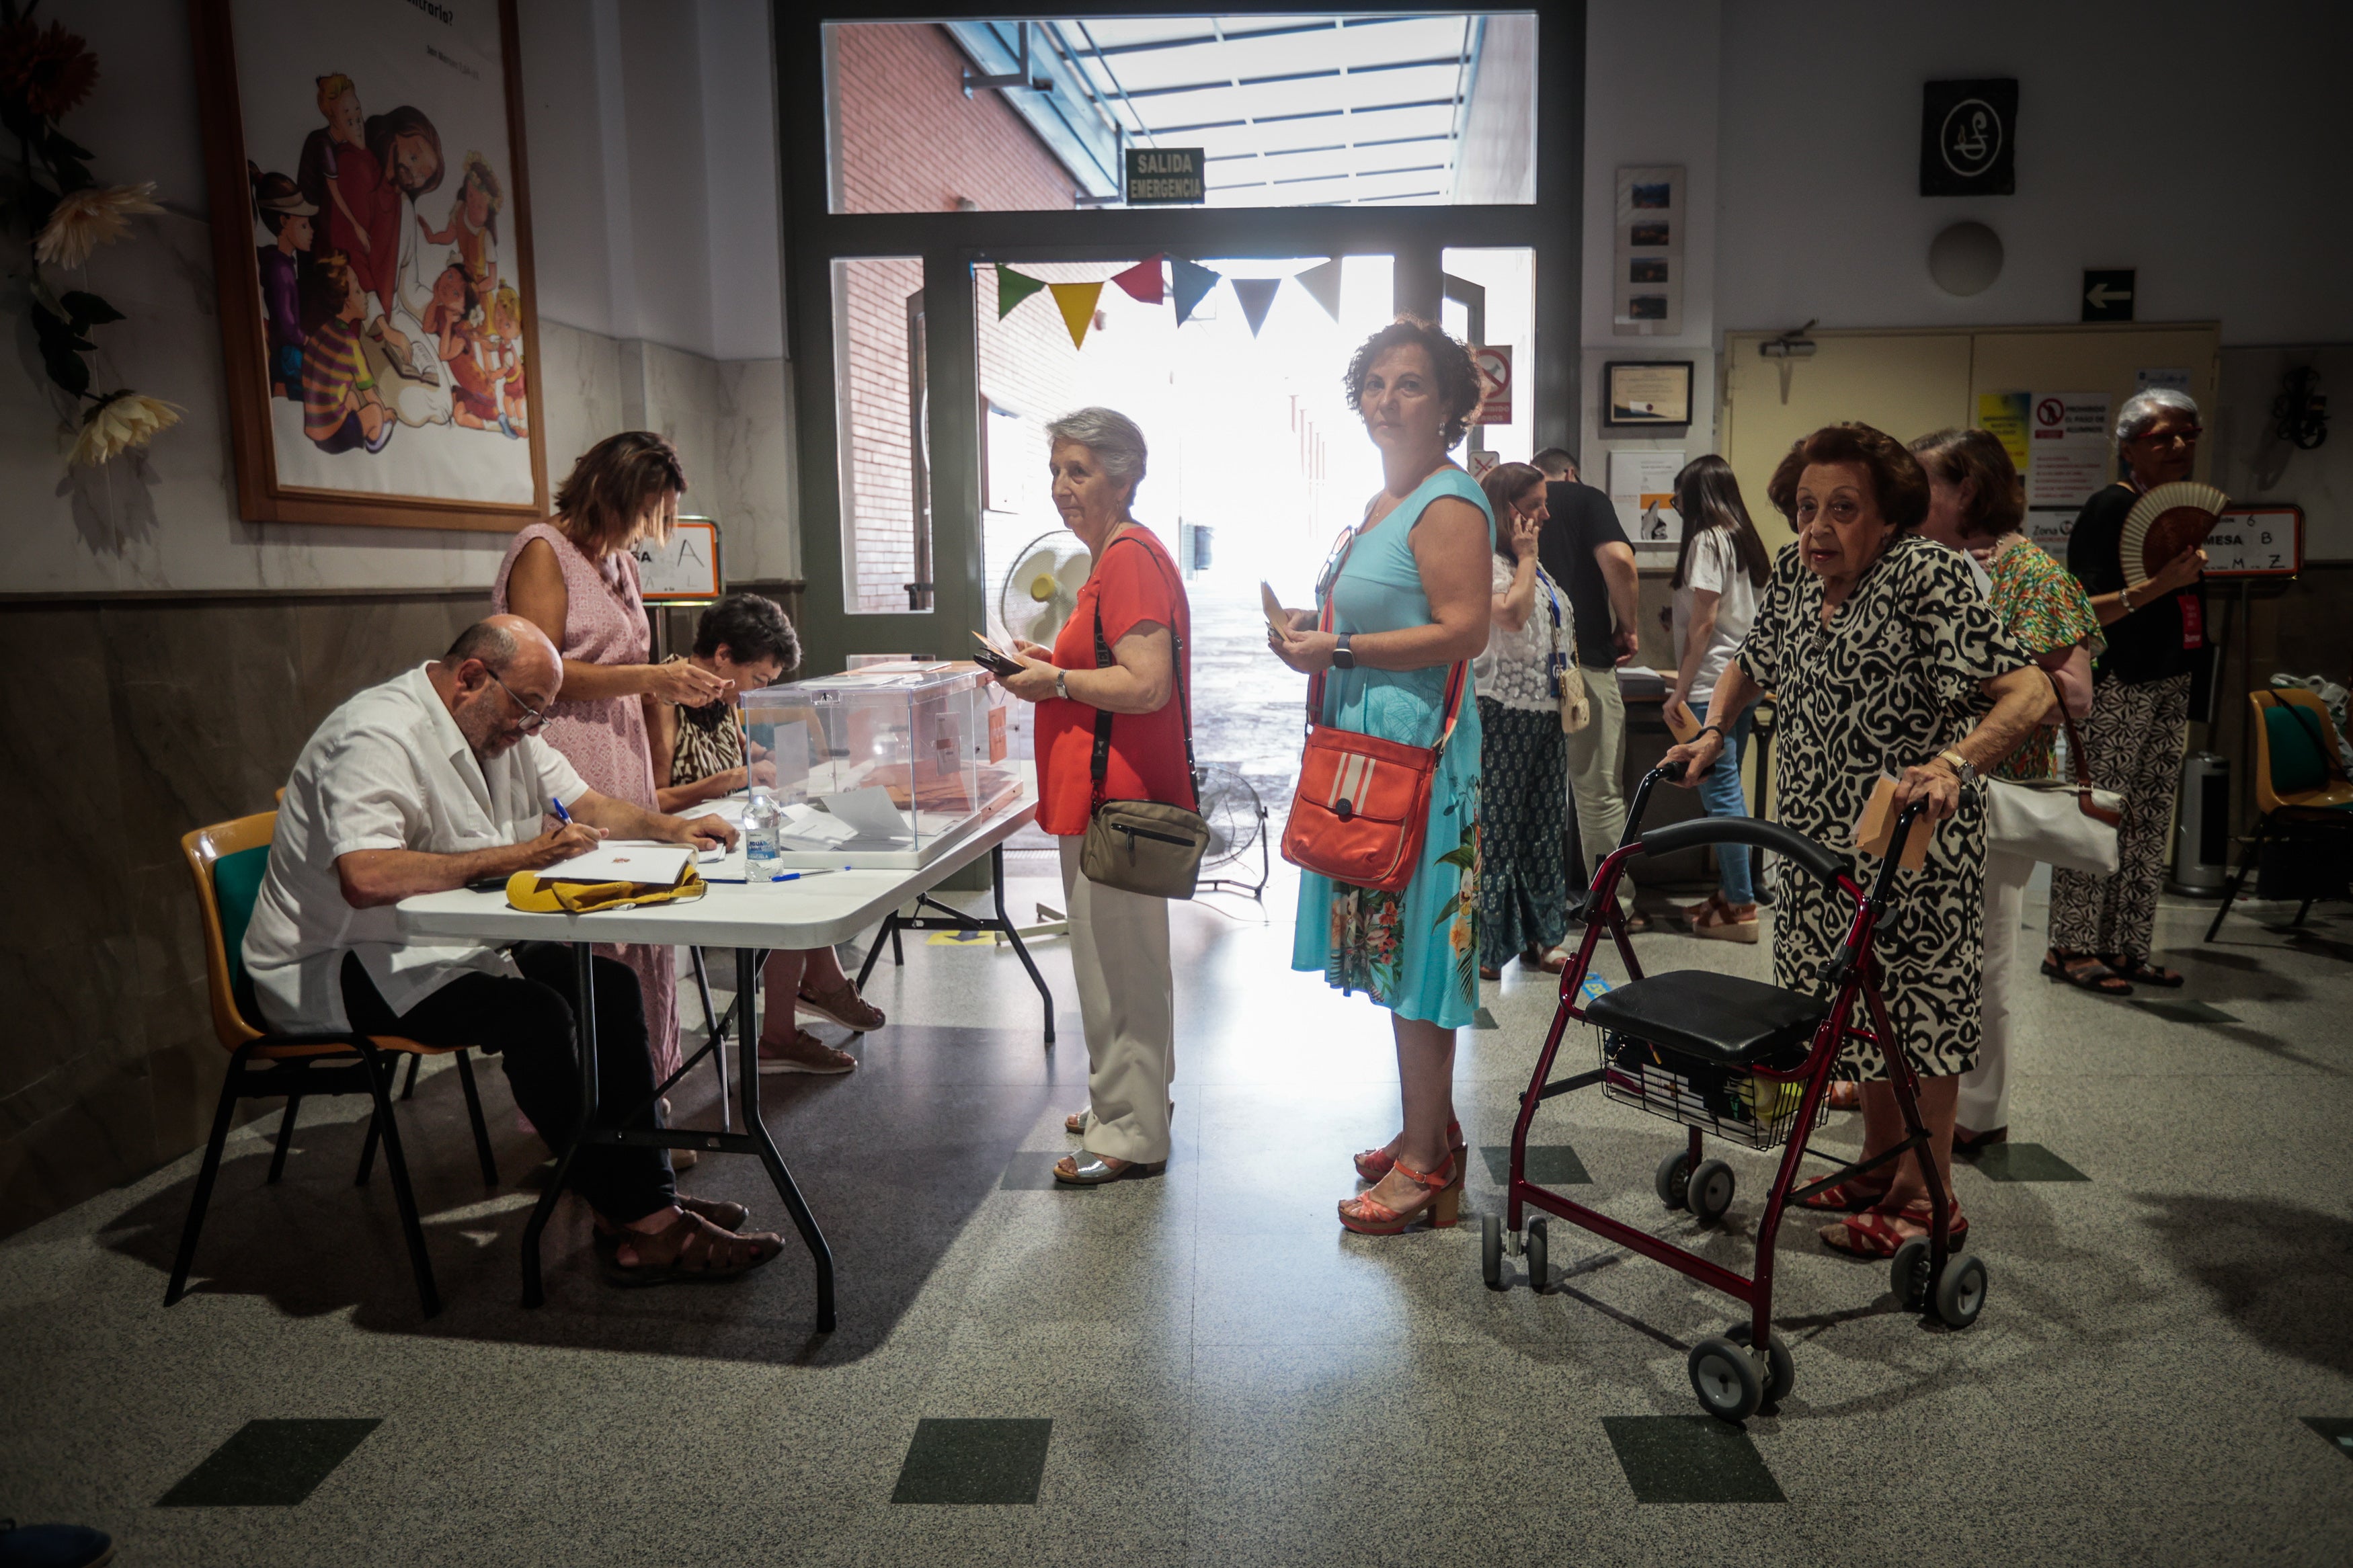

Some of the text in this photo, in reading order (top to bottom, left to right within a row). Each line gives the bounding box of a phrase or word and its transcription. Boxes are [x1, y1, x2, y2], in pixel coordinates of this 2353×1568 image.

[1137, 153, 1193, 174] SALIDA
[1130, 177, 1201, 199] EMERGENCIA
[2247, 515, 2256, 526] 6
[2032, 525, 2057, 536] Zona
[2204, 532, 2272, 546] MESA B
[678, 538, 705, 568] A
[2231, 558, 2245, 569] M
[2268, 554, 2286, 569] Z
